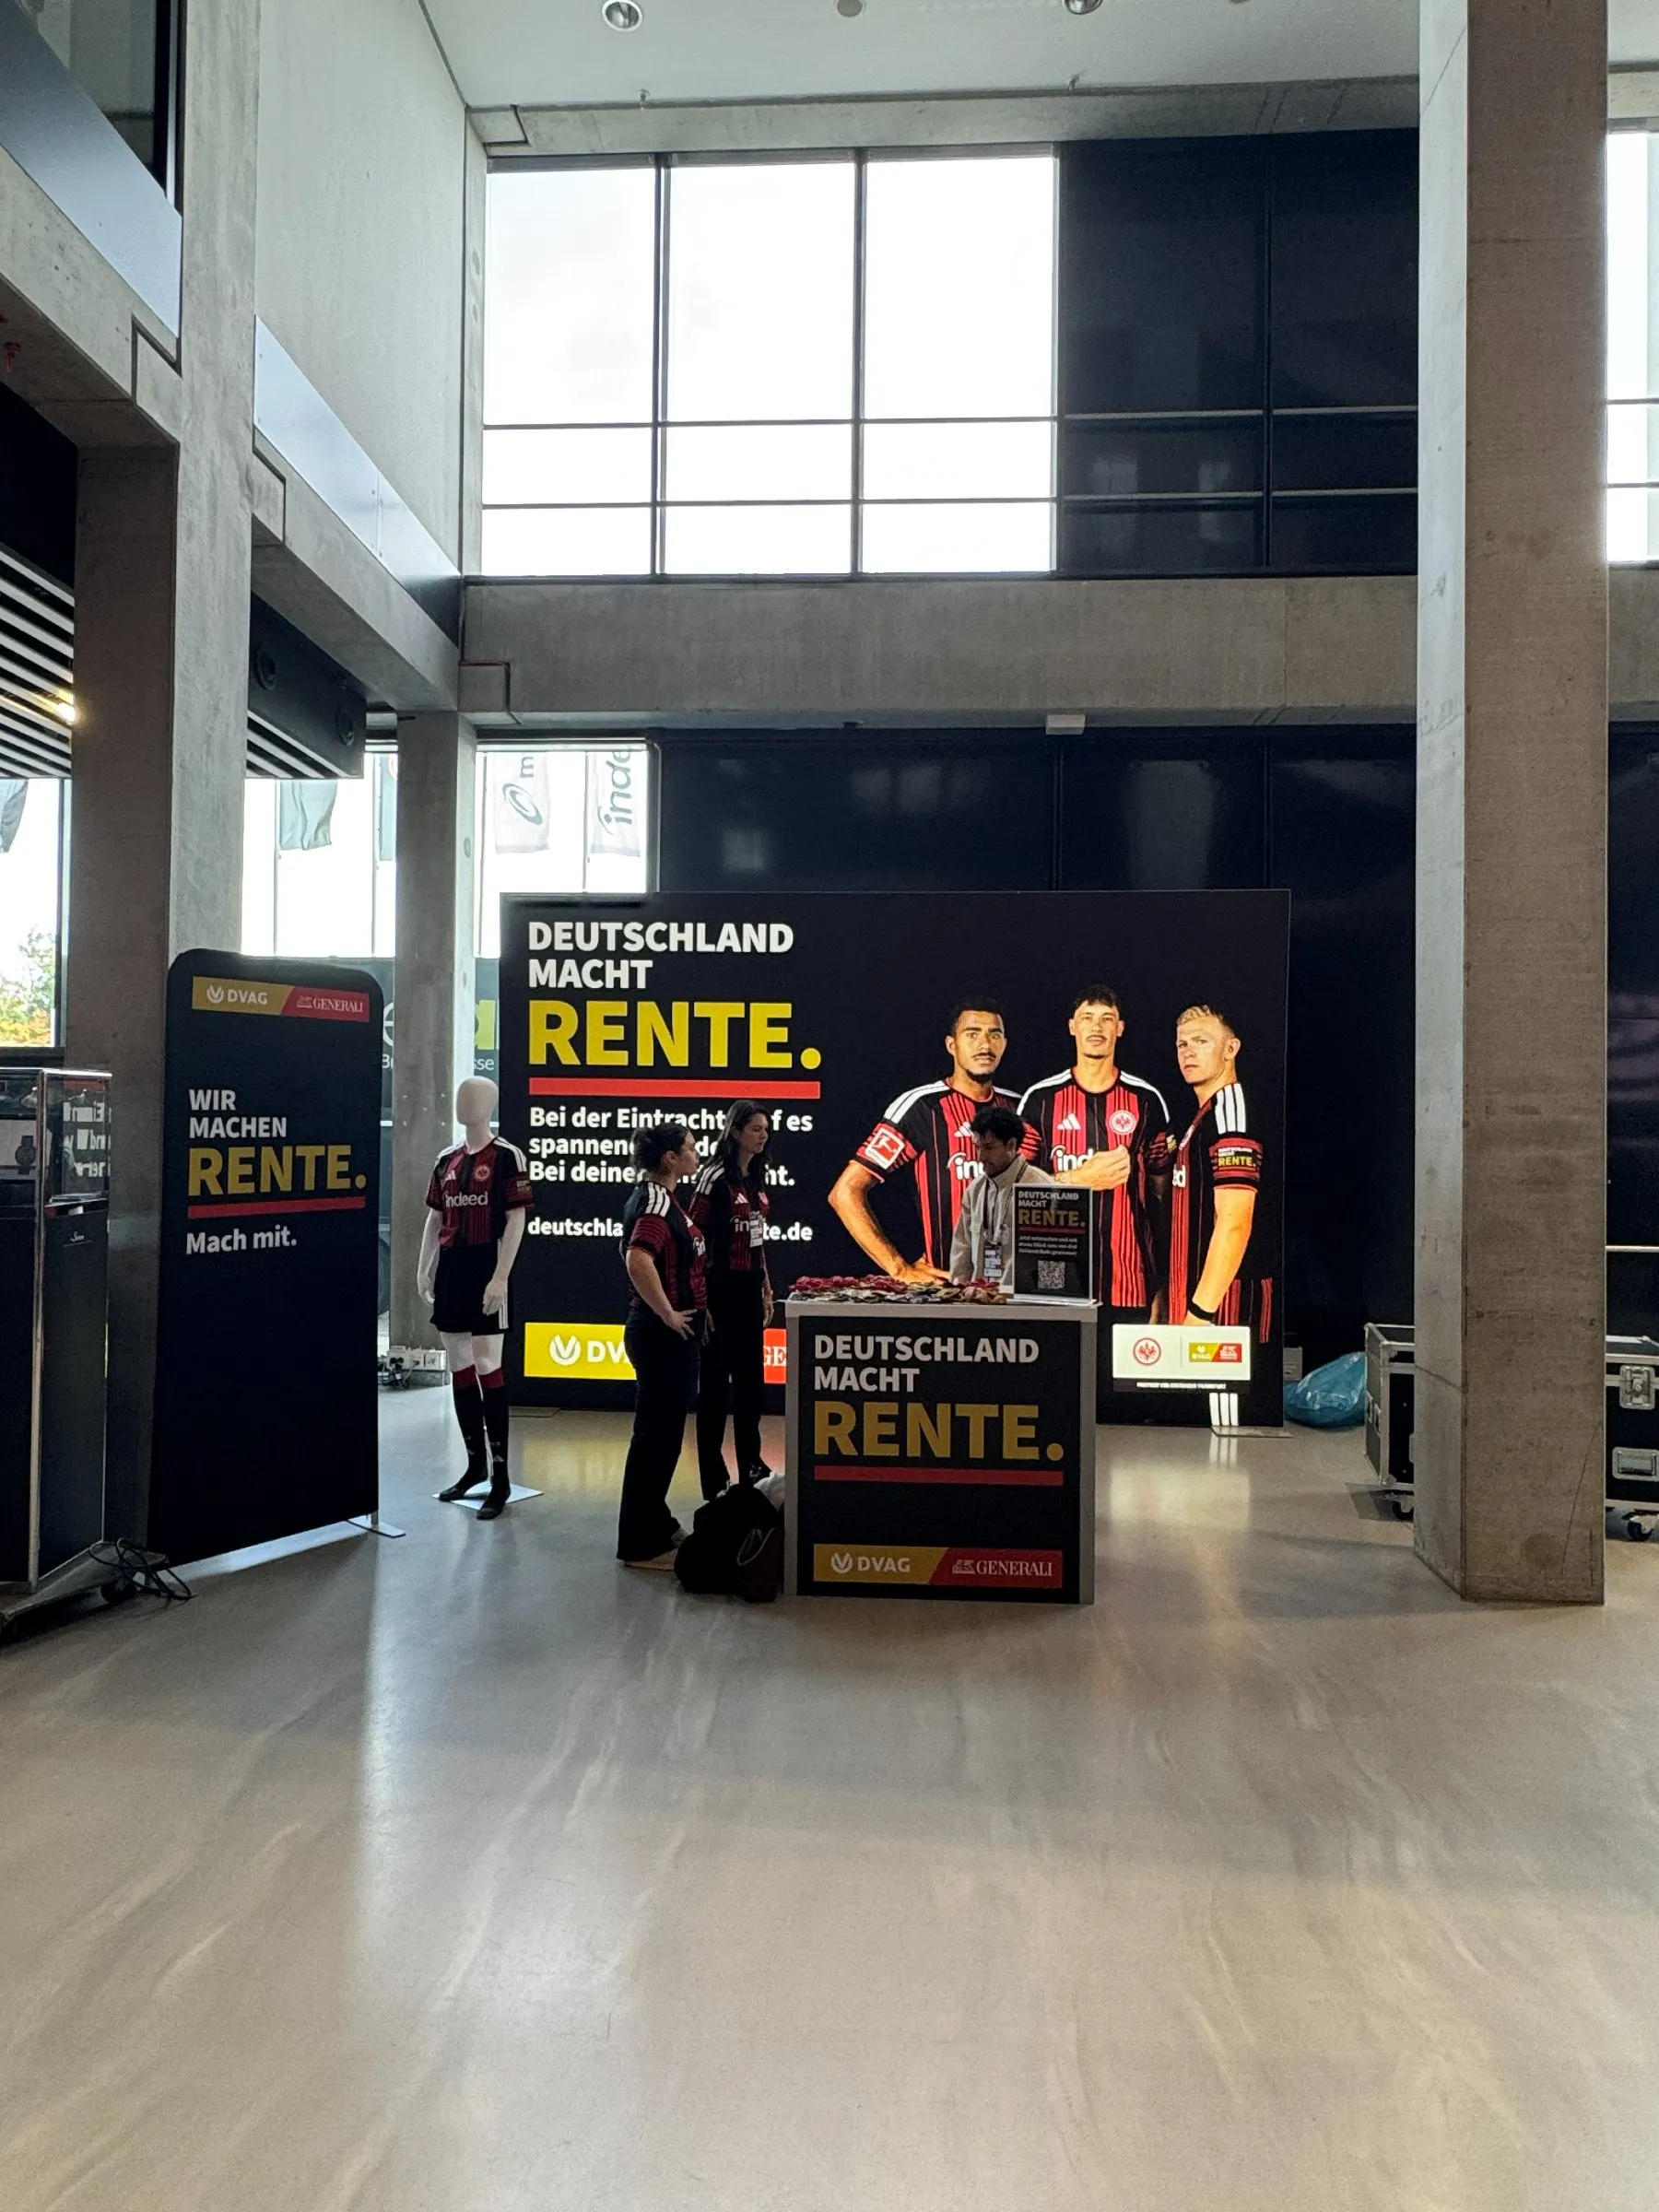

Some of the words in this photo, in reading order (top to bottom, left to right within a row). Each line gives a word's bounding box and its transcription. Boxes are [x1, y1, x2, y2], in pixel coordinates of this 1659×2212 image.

[528, 922, 794, 952] DEUTSCHLAND
[528, 959, 653, 989] MACHT
[227, 989, 268, 1005] DVAG
[312, 998, 363, 1013] GENERALI
[528, 1000, 822, 1070] RENTE.
[188, 1089, 237, 1112] WIR
[189, 1116, 288, 1139] MACHEN
[529, 1105, 567, 1127] Bei
[571, 1106, 612, 1128] der
[617, 1107, 727, 1131] Eintracht
[786, 1113, 813, 1132] es
[188, 1145, 368, 1196] RENTE.
[529, 1159, 566, 1182] Bei
[1218, 1156, 1257, 1168] RENTE.
[445, 1191, 488, 1208] indeed
[1018, 1190, 1079, 1201] DEUTSCHLAND
[1018, 1199, 1048, 1208] MACHT
[1018, 1208, 1086, 1228] RENTE.
[186, 1229, 246, 1254] Mach
[253, 1225, 297, 1251] mit.
[814, 1335, 1040, 1363] DEUTSCHLAND
[814, 1366, 921, 1393] MACHT
[814, 1400, 1065, 1462] RENTE.
[857, 1557, 912, 1573] DVAG
[976, 1559, 1053, 1577] GENERALI
